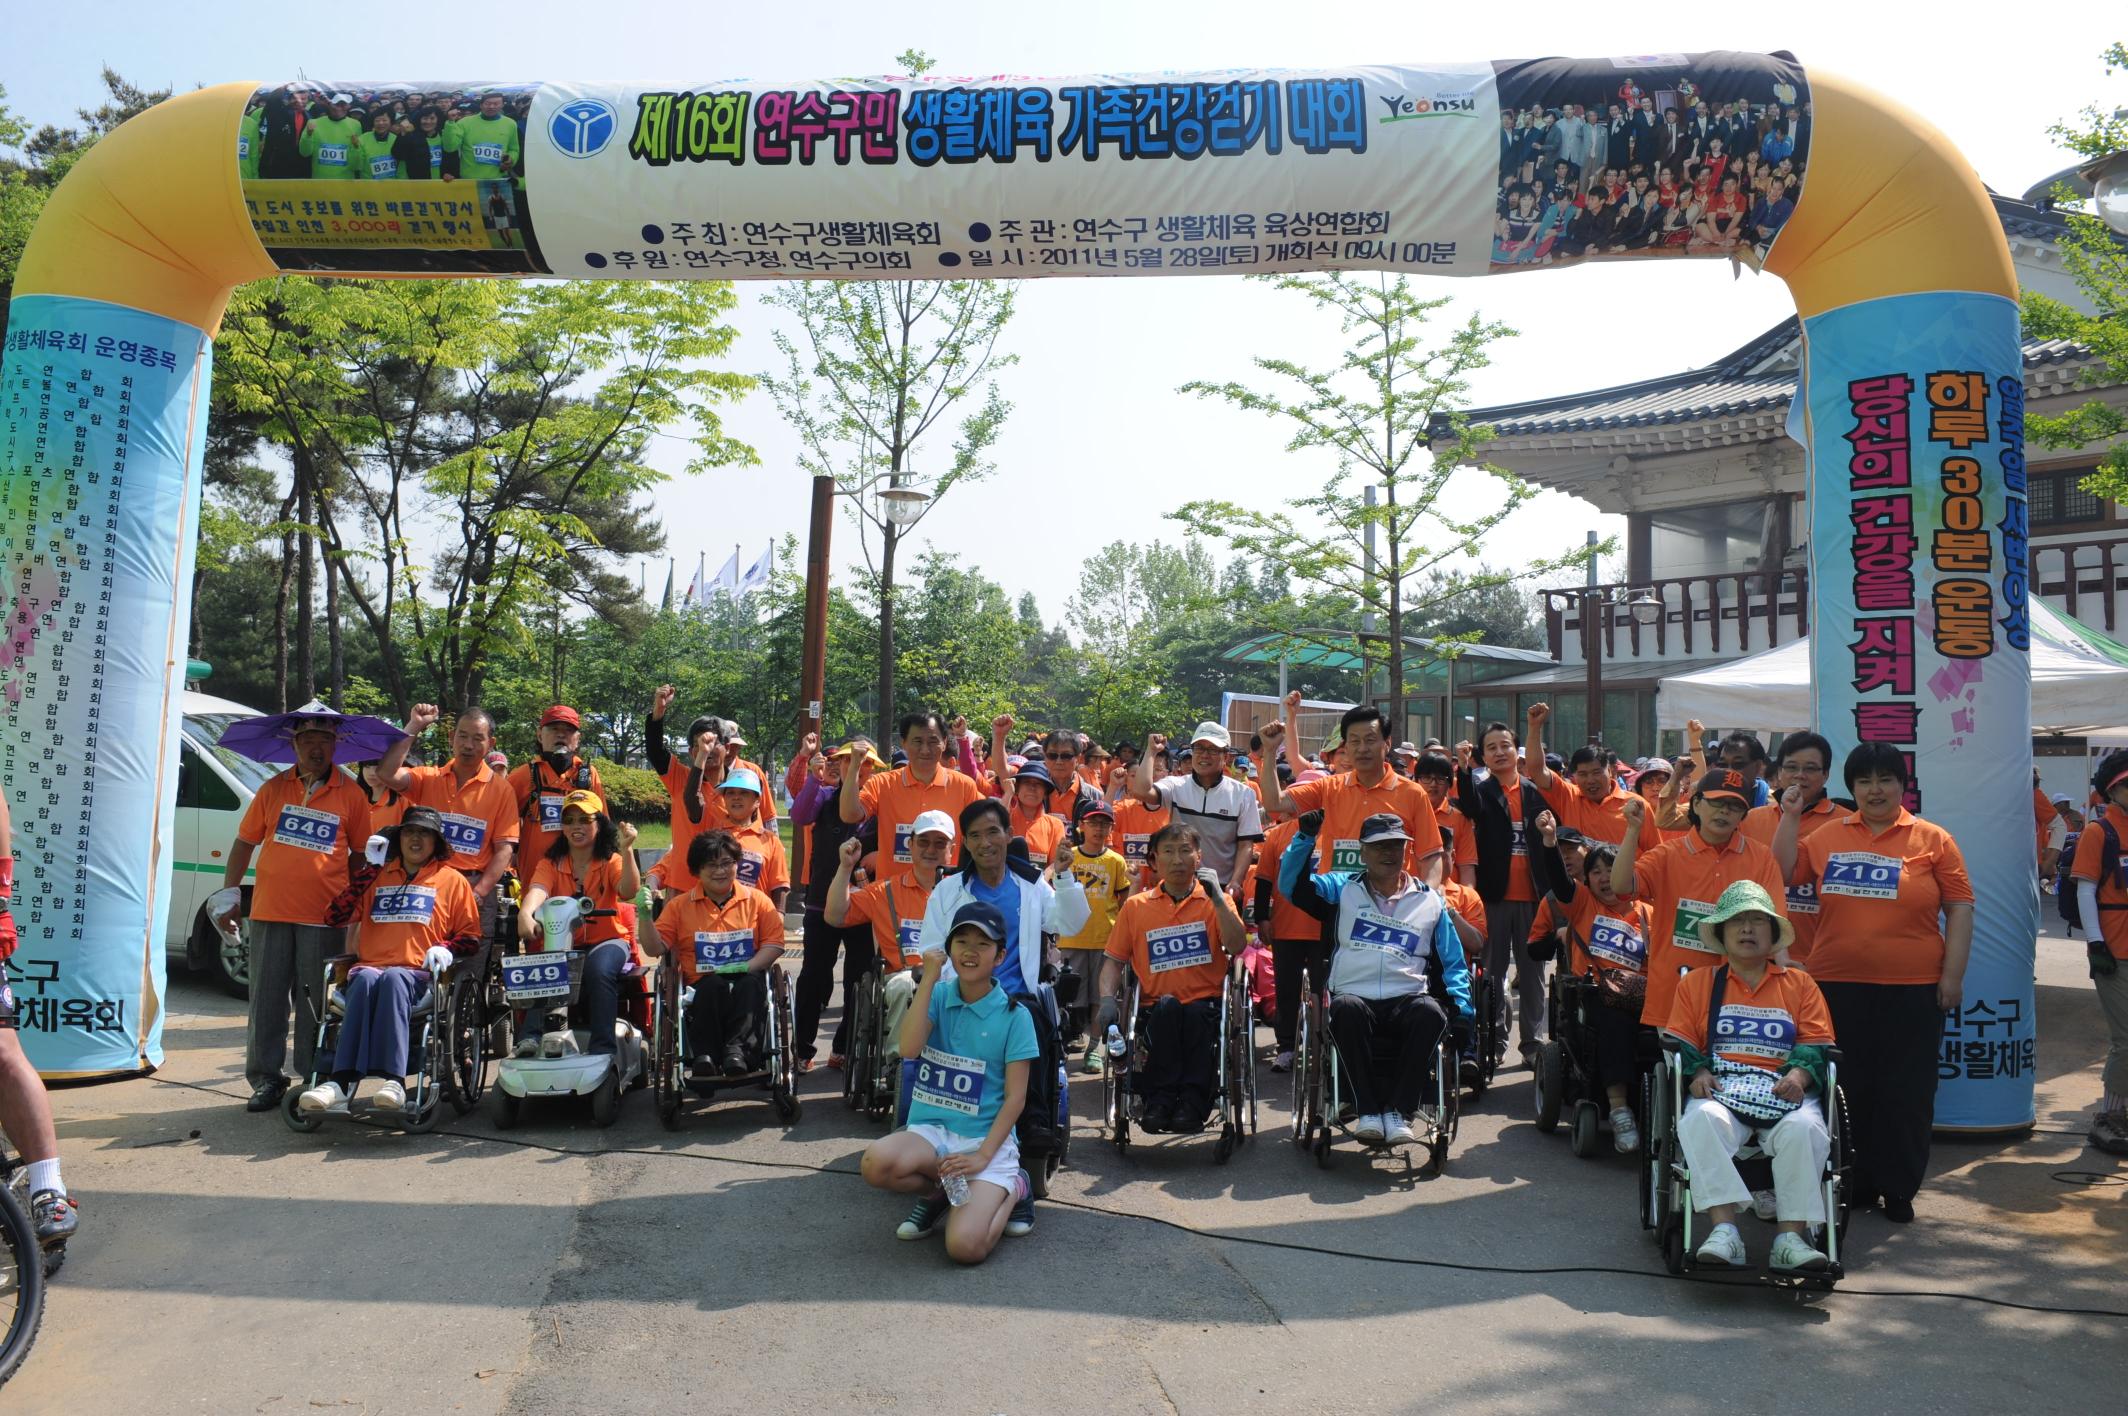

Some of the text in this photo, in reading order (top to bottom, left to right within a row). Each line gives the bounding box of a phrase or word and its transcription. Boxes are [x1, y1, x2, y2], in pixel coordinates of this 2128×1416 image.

[1380, 94, 1475, 119] Yeonsu
[631, 78, 1367, 168] 제16회 연수구민 생활체육 가족건강걷기 대회
[321, 150, 345, 160] 001
[475, 147, 501, 159] 008
[374, 163, 397, 173] 828
[351, 202, 380, 217] 위한
[296, 219, 325, 234] 인천
[407, 221, 437, 235] 걷기
[743, 221, 941, 247] 연수구생활체육회
[1073, 217, 1148, 243] 연수구
[1155, 213, 1257, 242] 생활체육
[1264, 210, 1390, 238] 육상연합회
[789, 250, 912, 270] 연수구의회
[1040, 247, 1118, 268] 2011년
[1124, 248, 1162, 268] 5월
[1265, 240, 1338, 262] 개회식
[1344, 239, 1396, 263] 09시
[1402, 241, 1456, 265] 00분
[6, 330, 177, 373] 생활체육회 운영종목
[1842, 373, 1915, 491] 당신의
[1926, 369, 1994, 659] 하루 30분 운동
[1849, 494, 1918, 611] 건강을
[1848, 616, 1916, 695] 지켜
[545, 806, 559, 818] 6
[284, 817, 331, 838] 646
[1126, 843, 1149, 855] 64
[740, 862, 754, 877] 2
[1832, 864, 1889, 881] 710
[379, 895, 426, 909] 634
[1684, 914, 1699, 930] 7
[1362, 923, 1409, 946] 711
[1595, 928, 1638, 953] 640
[703, 942, 746, 958] 644
[1152, 935, 1202, 956] 605
[511, 966, 560, 984] 649
[1716, 1018, 1784, 1039] 620
[919, 1063, 972, 1093] 610
